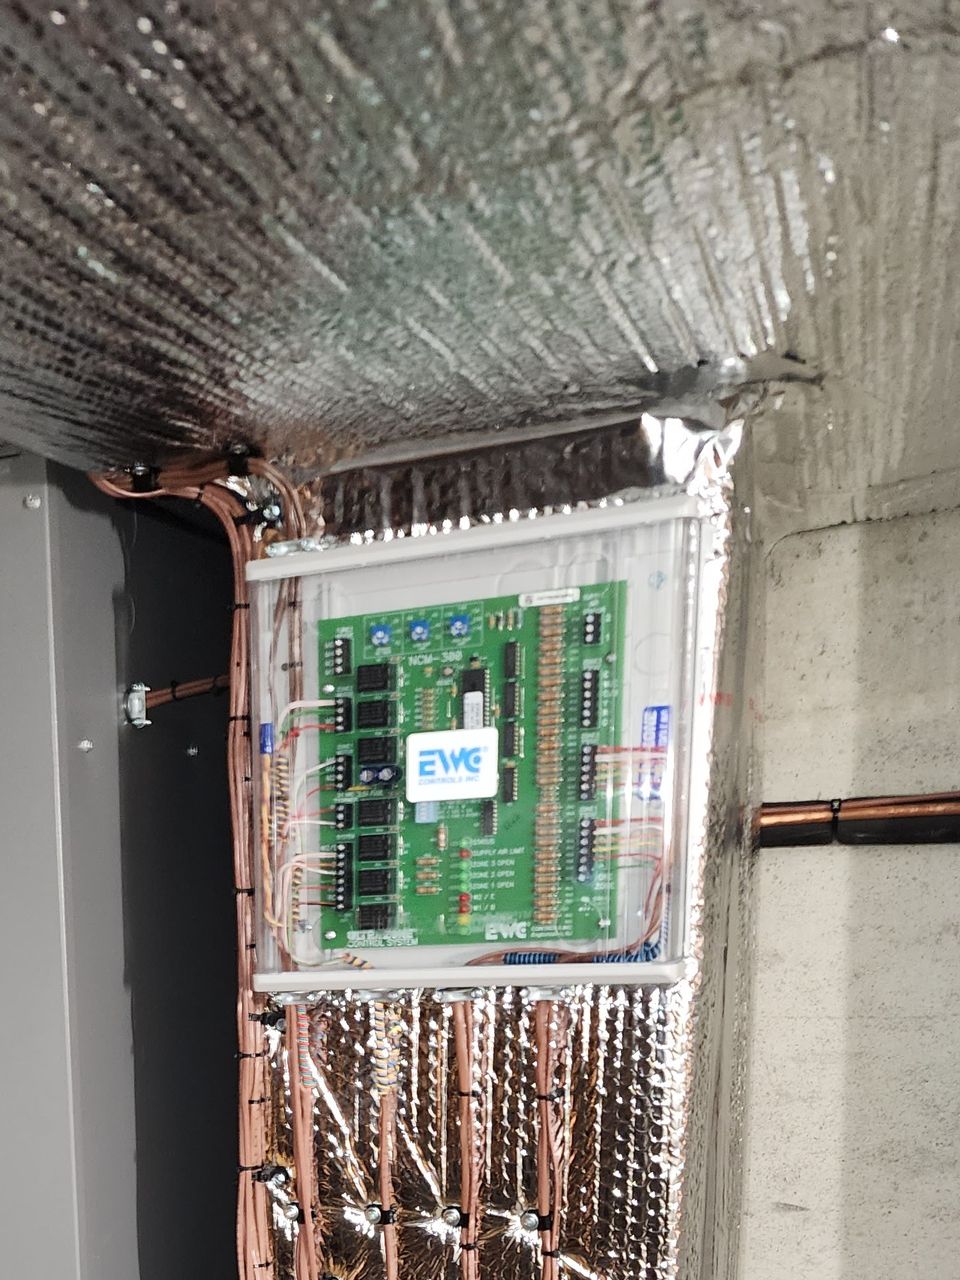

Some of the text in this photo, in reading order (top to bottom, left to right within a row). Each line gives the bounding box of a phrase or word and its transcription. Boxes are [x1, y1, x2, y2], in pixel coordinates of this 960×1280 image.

[418, 747, 483, 776] EWC
[418, 777, 462, 786] CONTROLS
[496, 881, 515, 889] OPEN
[485, 922, 527, 941] EWC
